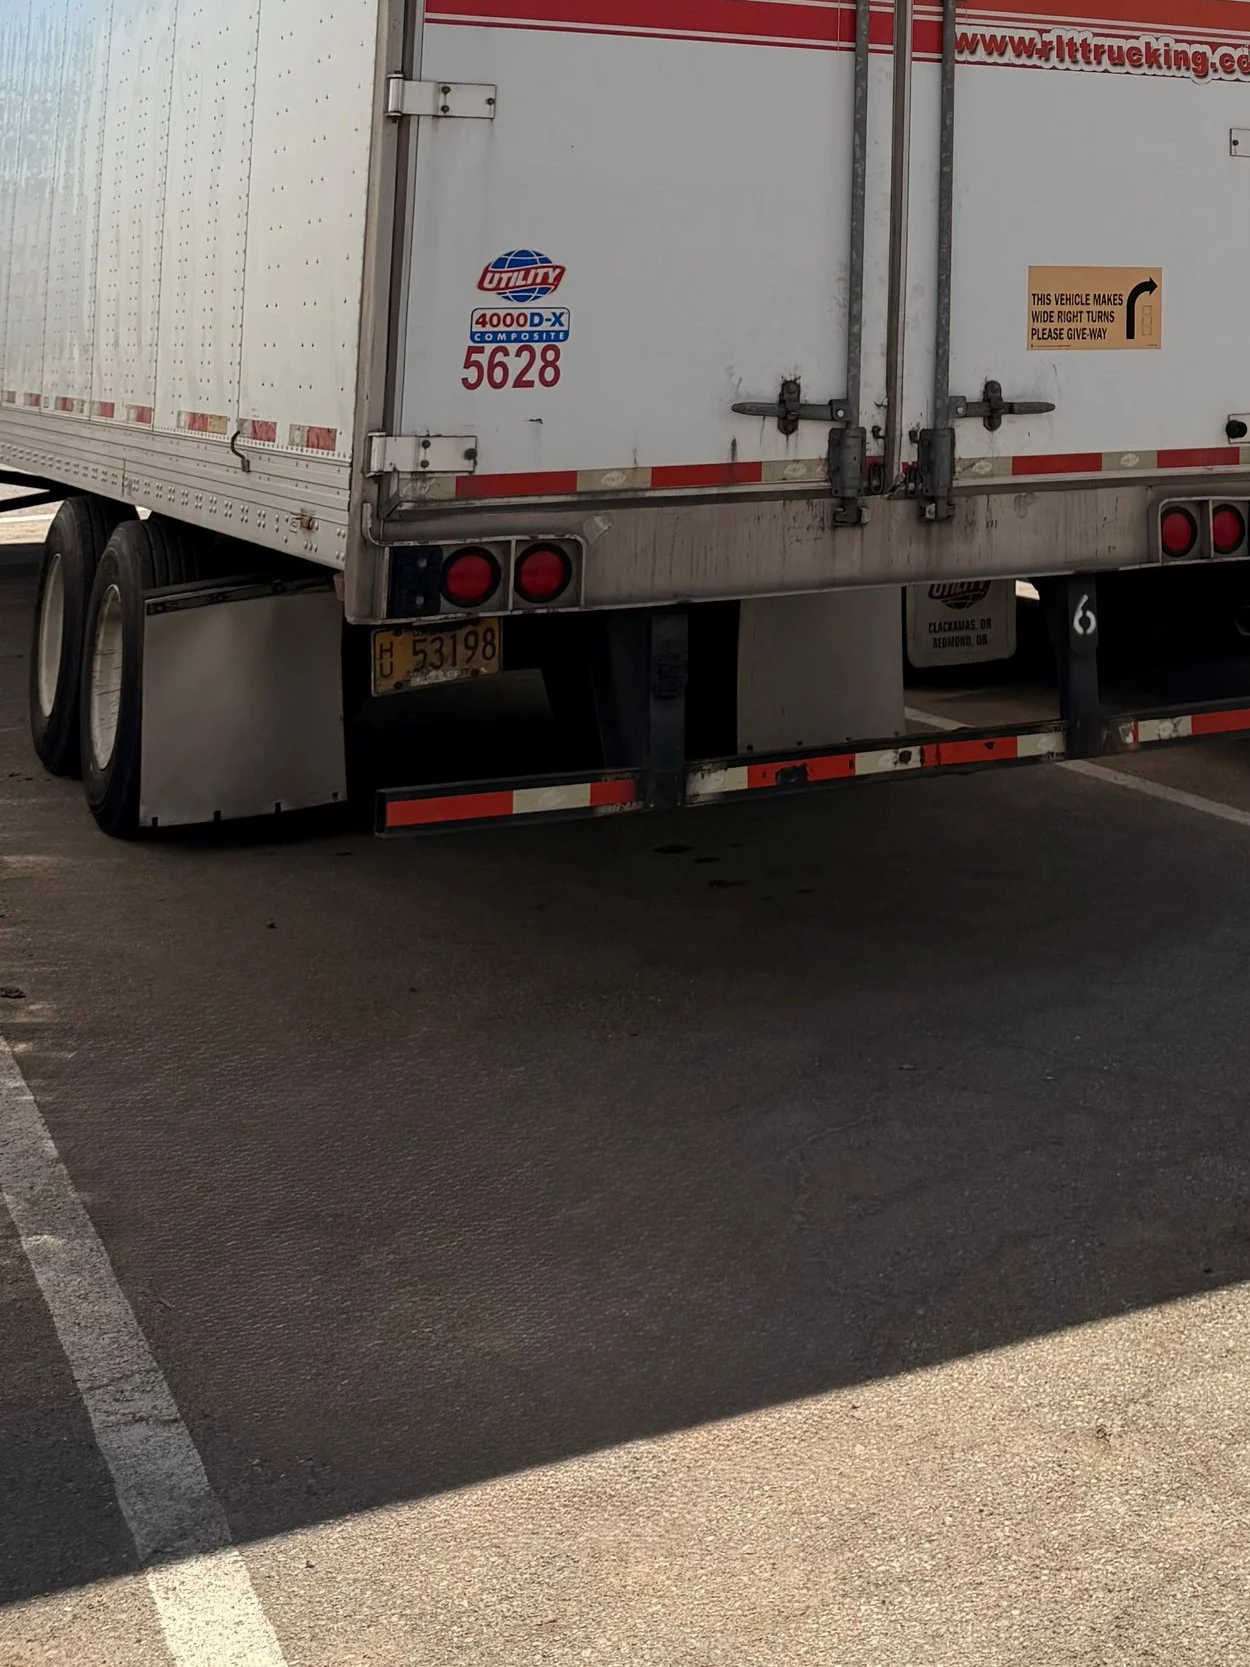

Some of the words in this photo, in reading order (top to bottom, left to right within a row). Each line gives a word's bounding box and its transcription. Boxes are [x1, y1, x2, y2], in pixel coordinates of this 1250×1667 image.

[483, 267, 561, 289] UTILITY
[1031, 293, 1052, 306] THIS
[1054, 293, 1091, 306] VEHICLE
[1093, 293, 1124, 306] MAKES
[474, 311, 565, 328] 4000D-X
[1031, 310, 1054, 323] WIDE
[1056, 310, 1083, 323] RIGHT
[1086, 310, 1115, 323] TURNS
[474, 331, 565, 341] COMPOSITE
[1031, 327, 1065, 341] PLEASE
[461, 344, 561, 391] 5628
[1072, 593, 1097, 635] 6
[980, 618, 992, 630] OR
[411, 626, 497, 673] 53198
